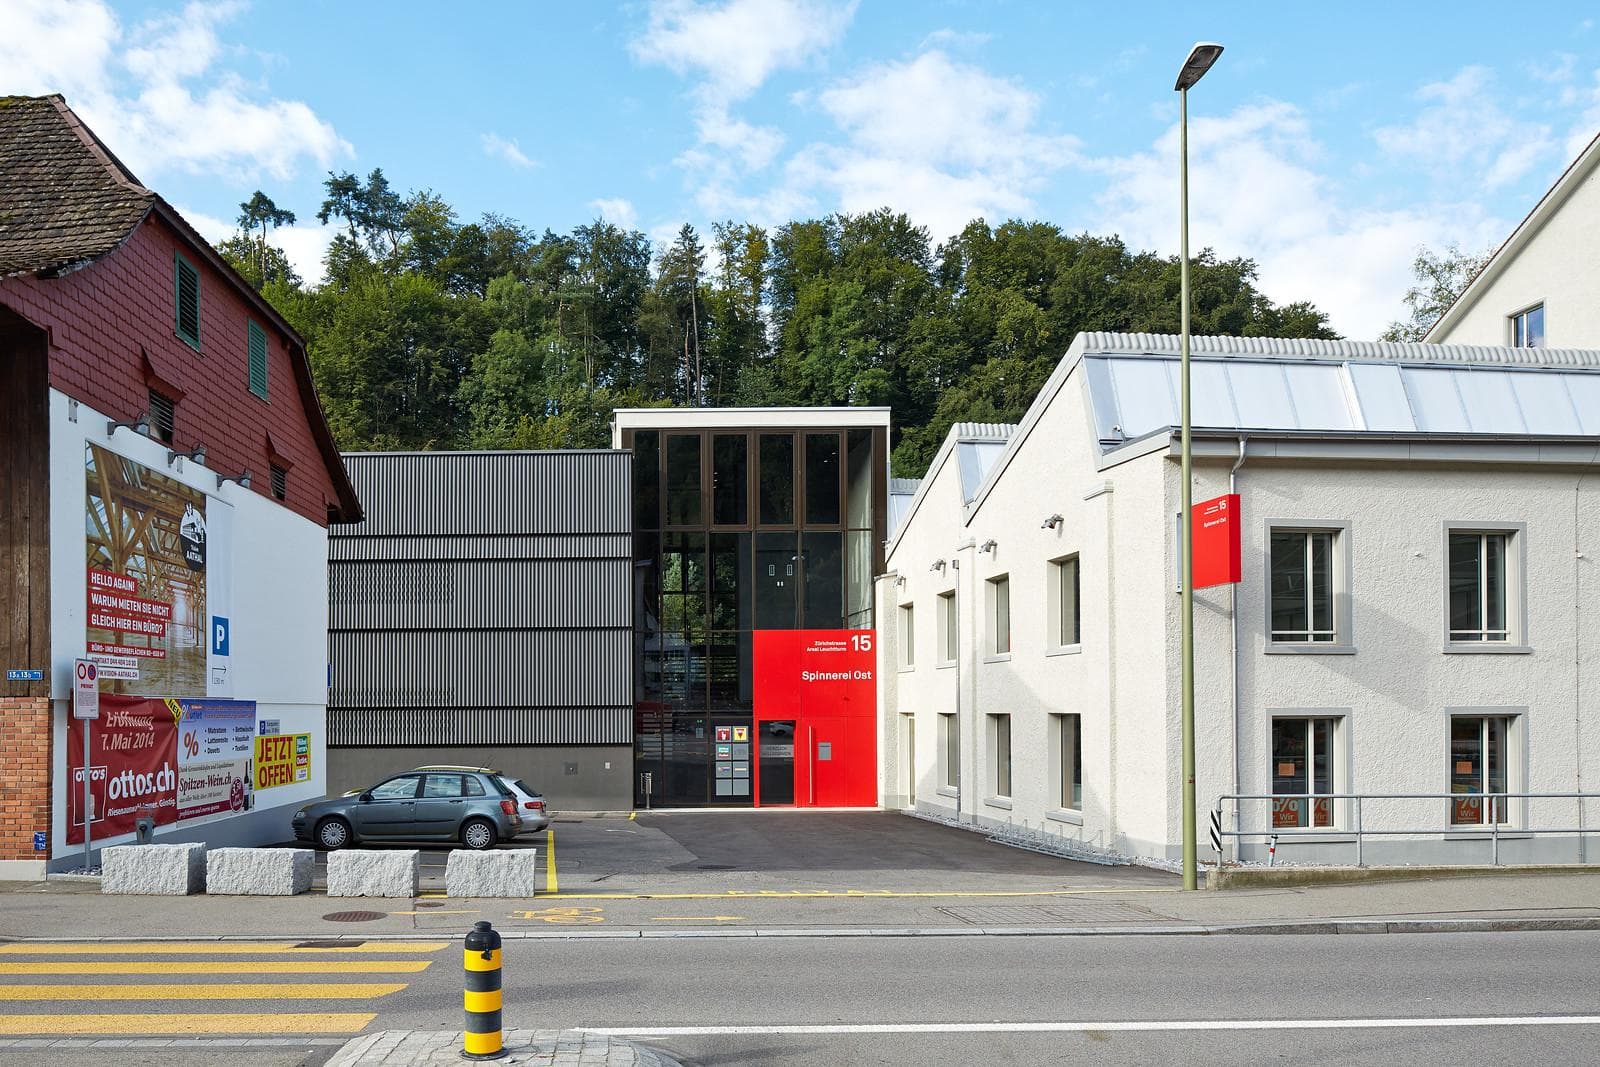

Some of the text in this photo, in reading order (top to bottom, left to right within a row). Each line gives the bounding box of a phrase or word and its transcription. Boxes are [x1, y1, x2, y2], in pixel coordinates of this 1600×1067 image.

[1219, 500, 1227, 510] 15
[91, 572, 135, 592] HELLO AGAIN!
[91, 592, 170, 617] WARUM MIETEN SIE NICHT
[91, 613, 163, 634] GLEICH HIER EIN BÜRO?
[216, 624, 225, 650] P
[851, 634, 872, 652] 15
[802, 670, 872, 682] Spinnerei Ost
[168, 699, 181, 718] NEU
[105, 711, 154, 730] Eröffnung
[101, 731, 154, 750] 7. Mai 2014
[258, 736, 293, 763] JETZT
[108, 761, 175, 800] ottos.ch
[179, 771, 232, 795] Spitzen-Wein.ch
[259, 763, 293, 788] OFFEN
